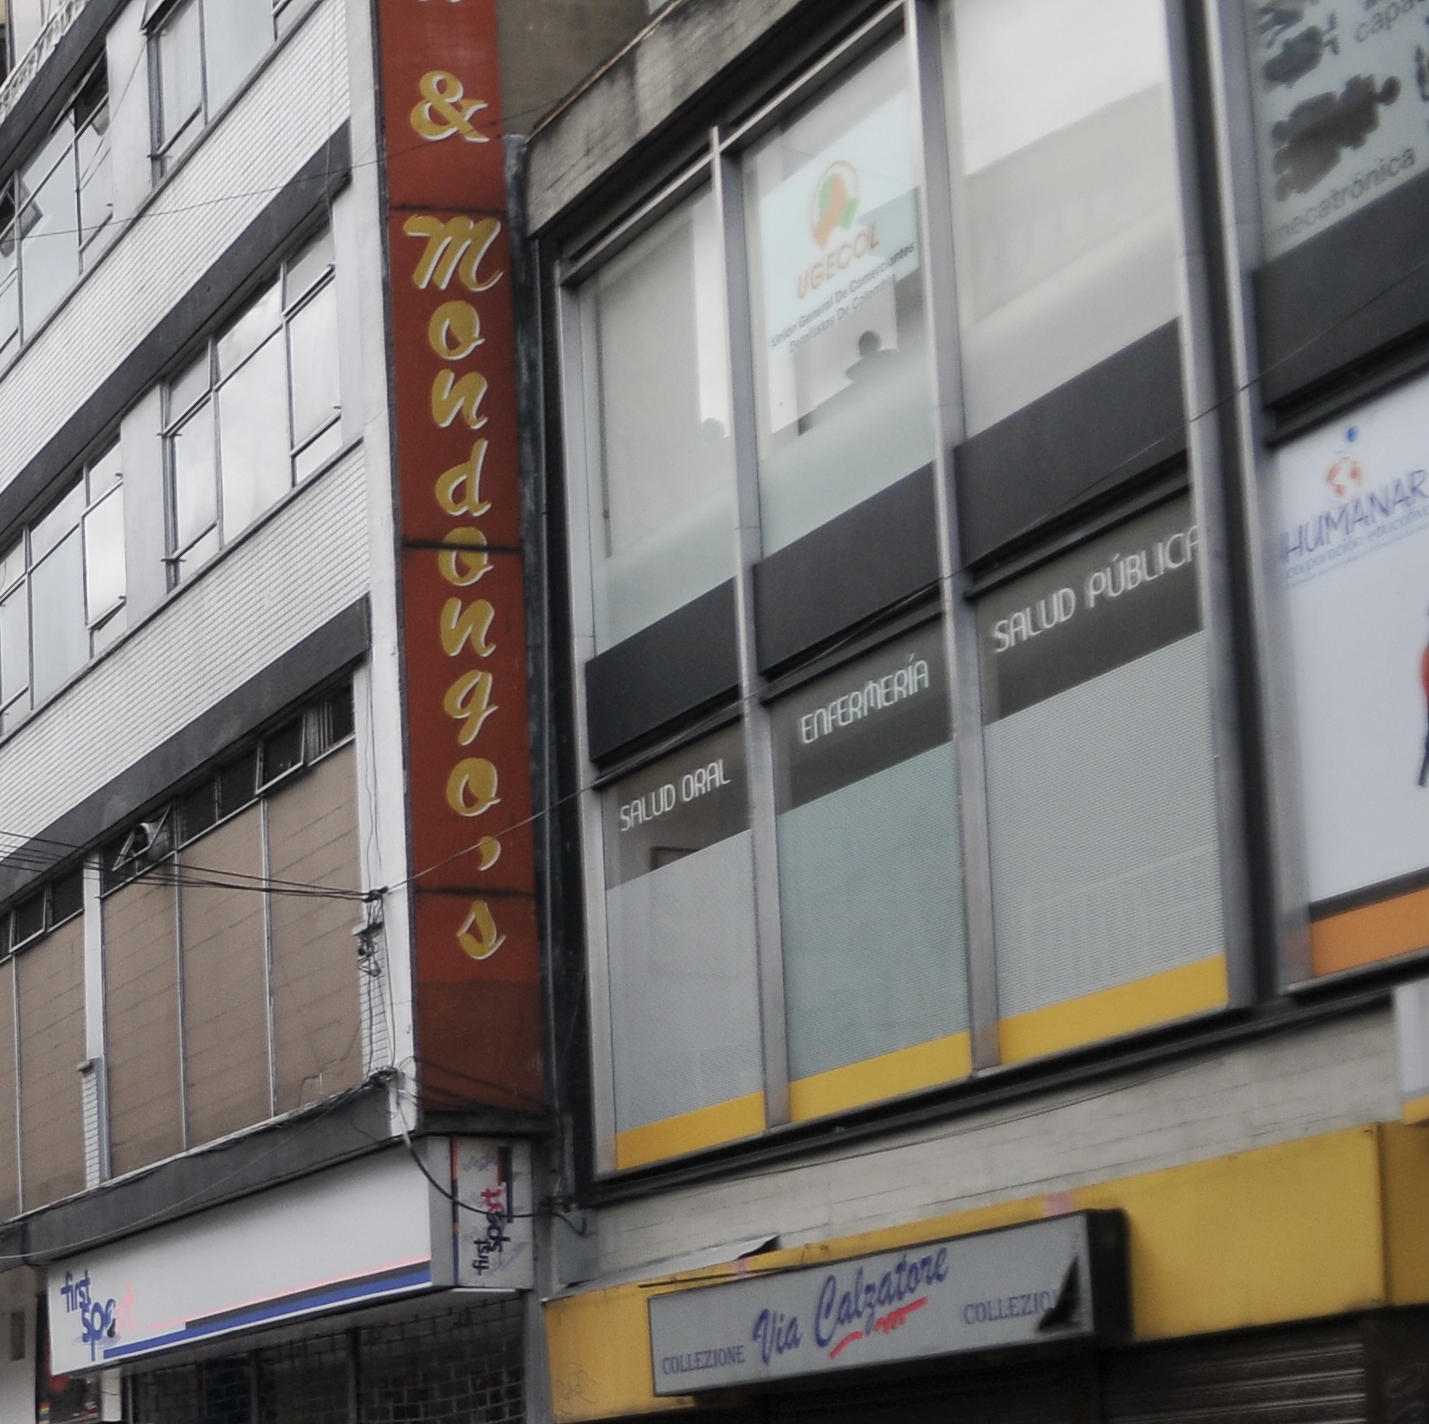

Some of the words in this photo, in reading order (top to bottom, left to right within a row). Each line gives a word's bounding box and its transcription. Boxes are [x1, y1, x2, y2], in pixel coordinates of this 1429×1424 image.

[411, 70, 490, 142] &
[797, 221, 880, 299] UGECOL
[992, 586, 1076, 654] SALUD
[799, 653, 930, 746] ENFERMERÍA
[619, 779, 677, 832] SALUD
[681, 757, 731, 804] ORAL
[60, 1269, 92, 1313] first
[472, 1237, 490, 1276] first
[661, 1344, 746, 1377] COLLEZIONE
[752, 1306, 803, 1366] Via
[813, 1246, 949, 1349] Calzatore
